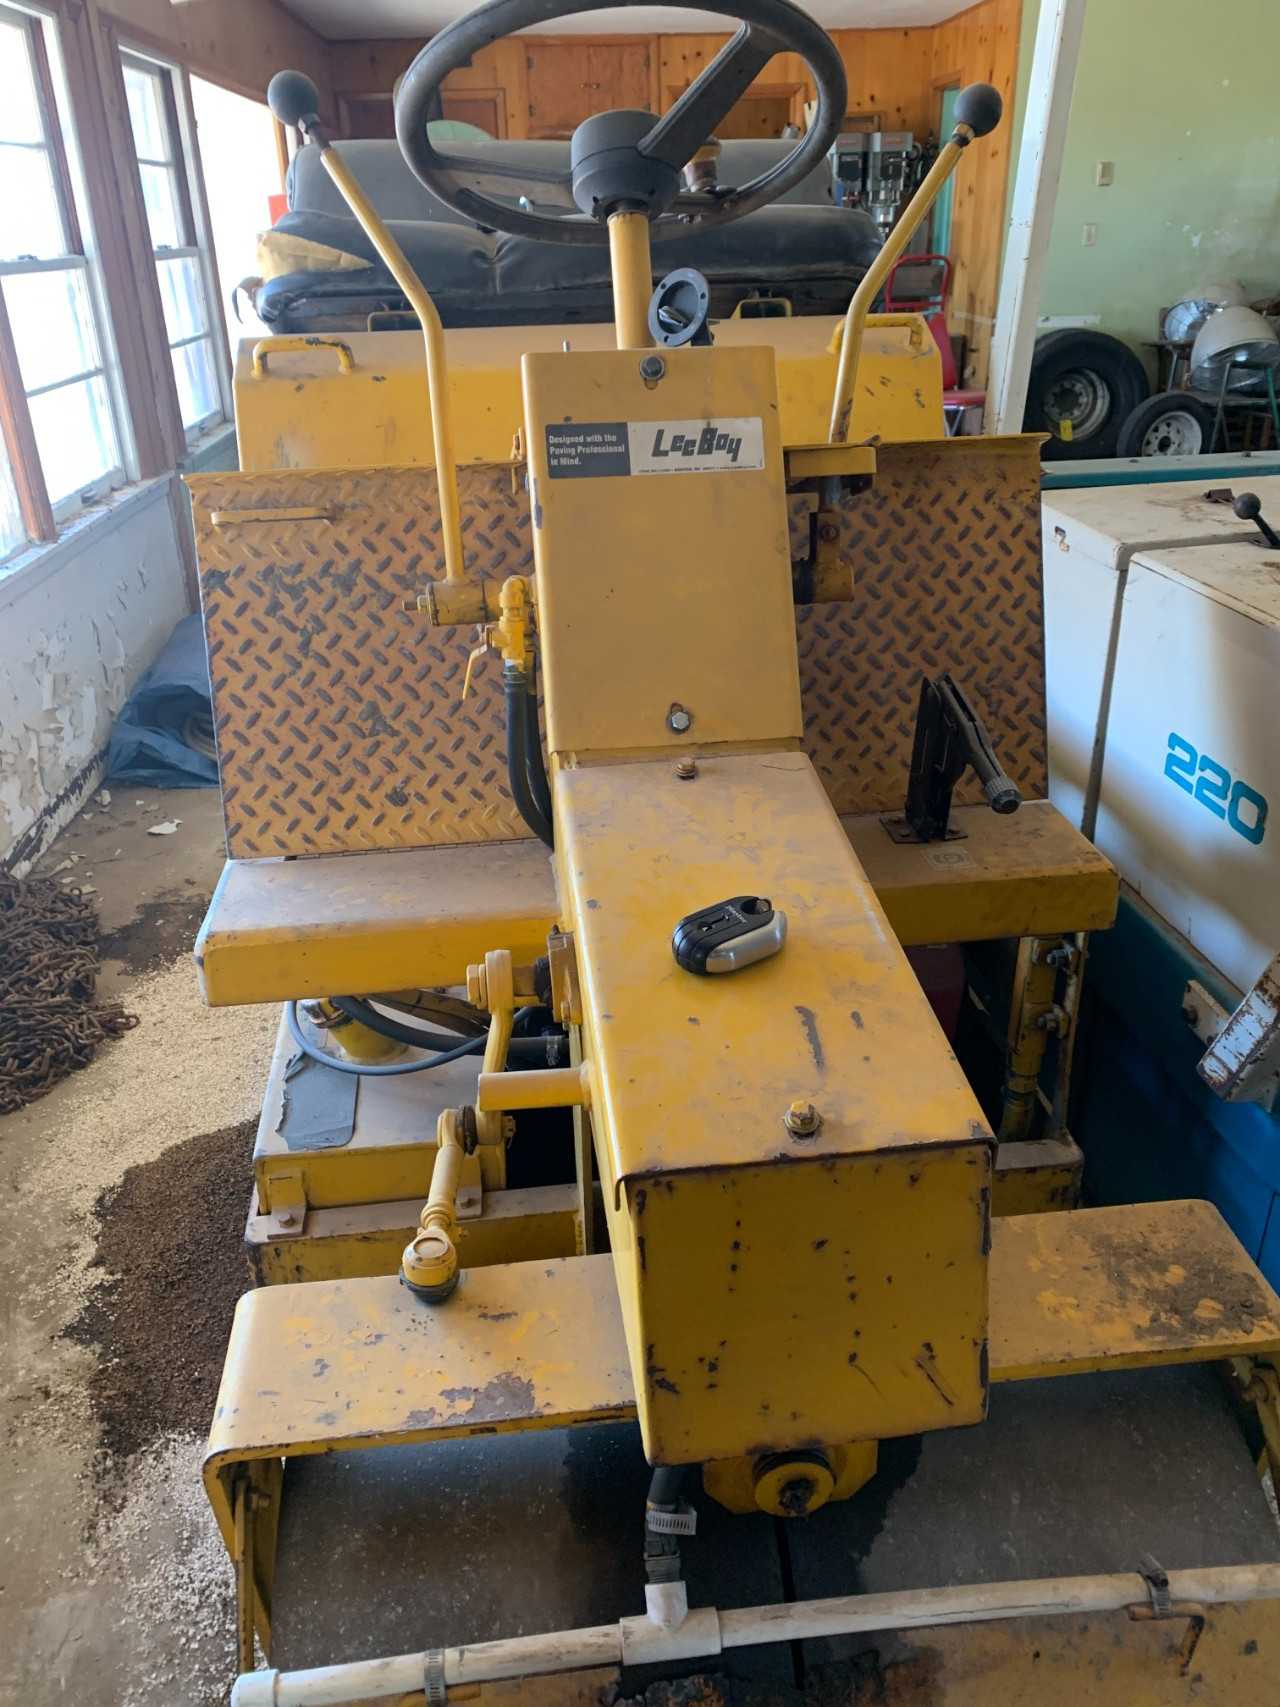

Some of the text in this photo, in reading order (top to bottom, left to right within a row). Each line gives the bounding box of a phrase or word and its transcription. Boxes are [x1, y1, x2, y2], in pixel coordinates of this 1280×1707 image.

[549, 434, 617, 445] Designed with the
[550, 444, 625, 455] Paving Professional
[651, 427, 743, 462] LeeBoy
[1164, 732, 1269, 845] 220
